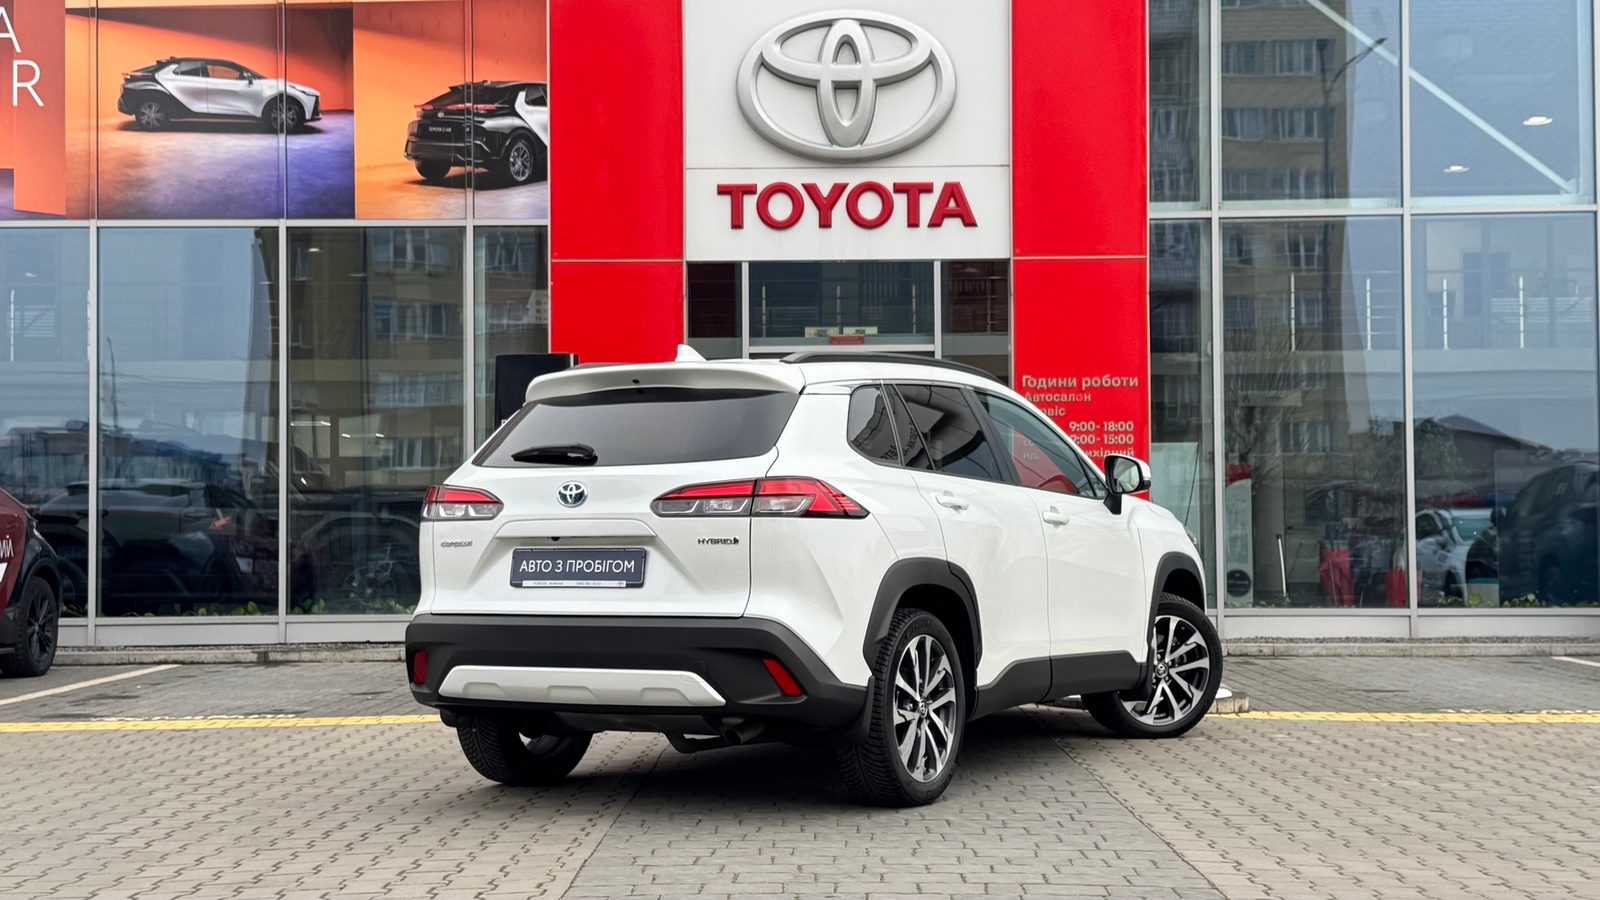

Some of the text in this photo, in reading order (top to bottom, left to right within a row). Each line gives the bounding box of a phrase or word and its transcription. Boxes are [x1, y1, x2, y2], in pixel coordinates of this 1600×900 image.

[12, 59, 45, 107] R
[717, 181, 978, 231] TOYOTA
[1022, 374, 1139, 390] Години роботи
[1024, 392, 1091, 402] Автосалон
[1085, 447, 1134, 457] ихідний
[697, 537, 734, 546] HYBRID
[519, 559, 553, 573] АВТО
[566, 559, 635, 573] ПРОБІГОМ
